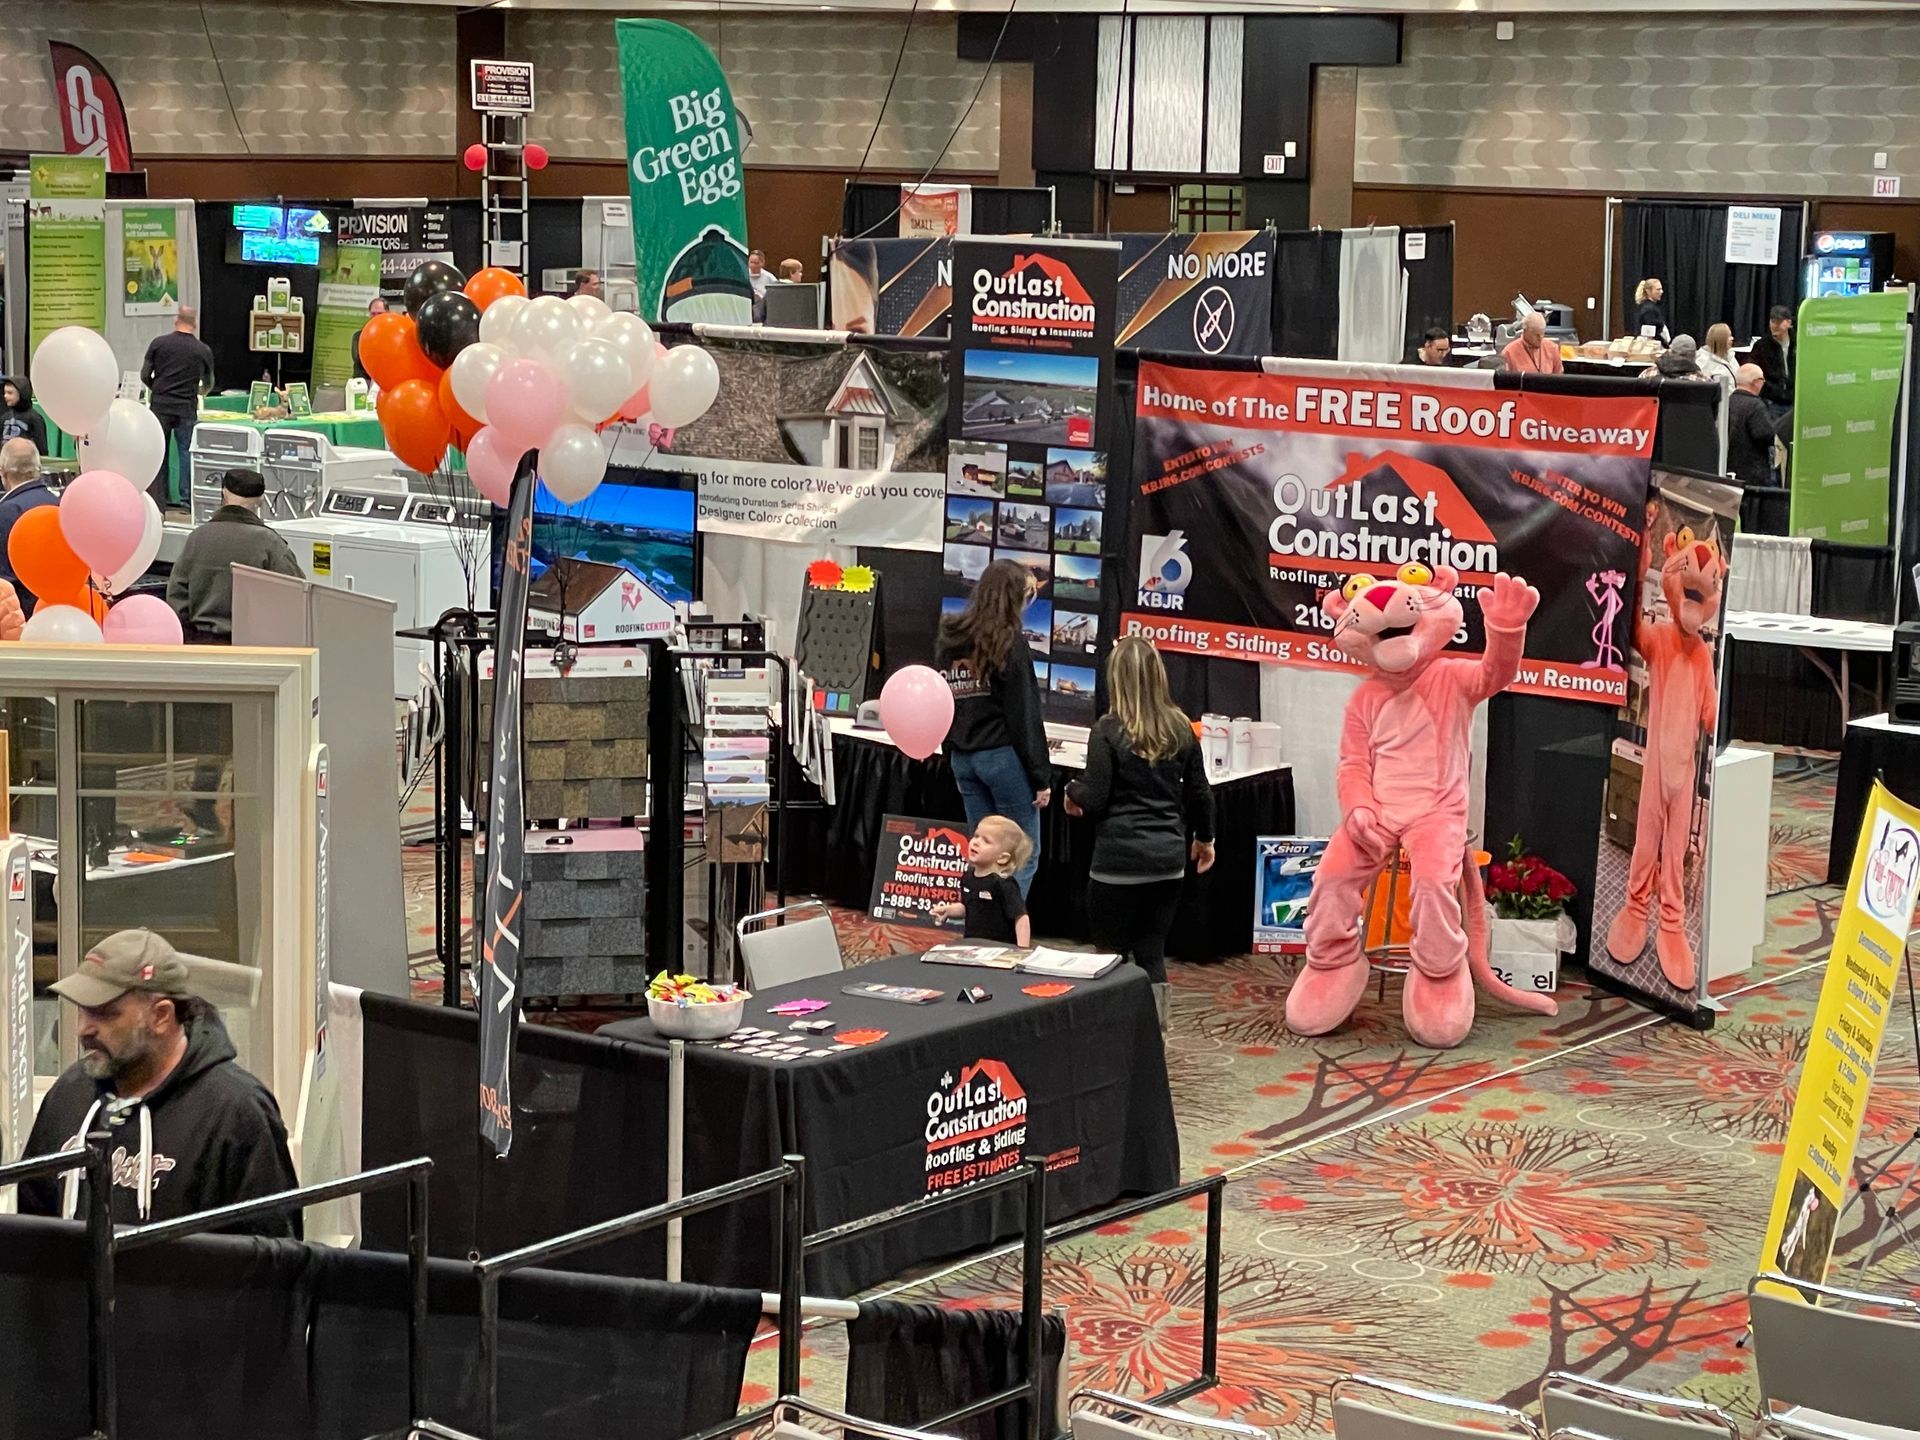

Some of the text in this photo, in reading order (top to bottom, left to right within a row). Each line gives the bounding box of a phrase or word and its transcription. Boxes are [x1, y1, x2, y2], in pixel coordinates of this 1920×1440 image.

[485, 66, 529, 76] PROVISION
[668, 87, 726, 134] Big
[632, 127, 733, 184] Green
[1266, 157, 1283, 170] EXIT
[677, 157, 741, 206] Egg
[1877, 180, 1897, 194] EXIT
[1732, 211, 1777, 220] DELI MENU
[1834, 238, 1866, 250] pepsi
[1167, 251, 1267, 280] NO MORE
[973, 268, 1063, 297] OutLast
[972, 292, 1096, 323] Construction
[972, 323, 1009, 335] Roofing,
[1011, 325, 1037, 336] Siding
[1049, 327, 1094, 338] Insulation
[1143, 385, 1650, 451] Home of The FREE Roof Giveaway
[1163, 450, 1197, 472] ENTE
[711, 471, 728, 485] for
[733, 474, 767, 488] more
[771, 477, 812, 492] color?
[816, 478, 854, 495] We've
[855, 482, 877, 499] got
[880, 486, 908, 500] you
[1273, 473, 1438, 526] OutLast
[699, 505, 838, 529] Designer Colors Collection
[742, 496, 778, 509] Duration
[781, 499, 805, 511] Series
[1511, 468, 1641, 547] KBJR6.COM/CONTEST
[1583, 487, 1600, 504] TO
[1601, 496, 1628, 518] WIN
[1268, 514, 1498, 573] Construction
[1269, 566, 1332, 588] Roofing,
[1137, 590, 1184, 611] KBJR
[615, 621, 671, 634] ROOFING CENTER
[1126, 620, 1209, 649] Roofing
[1225, 631, 1291, 660] Siding
[1306, 641, 1368, 666] Stor
[900, 834, 962, 857] OutLast
[883, 881, 919, 897] STORM
[895, 870, 934, 887] Roofing
[936, 876, 945, 886] &
[1845, 954, 1871, 987] Wednesday
[15, 927, 30, 1101] Andersen
[1839, 1013, 1852, 1038] Friday
[1856, 1028, 1873, 1058] Saturday
[926, 1076, 1002, 1118] OutLast
[924, 1096, 1028, 1143] Construction
[925, 1126, 1027, 1171] Roofing & Siding
[1822, 1133, 1838, 1161] Sunday
[927, 1168, 961, 1190] FREE
[963, 1150, 1020, 1180] ESTIMATES
